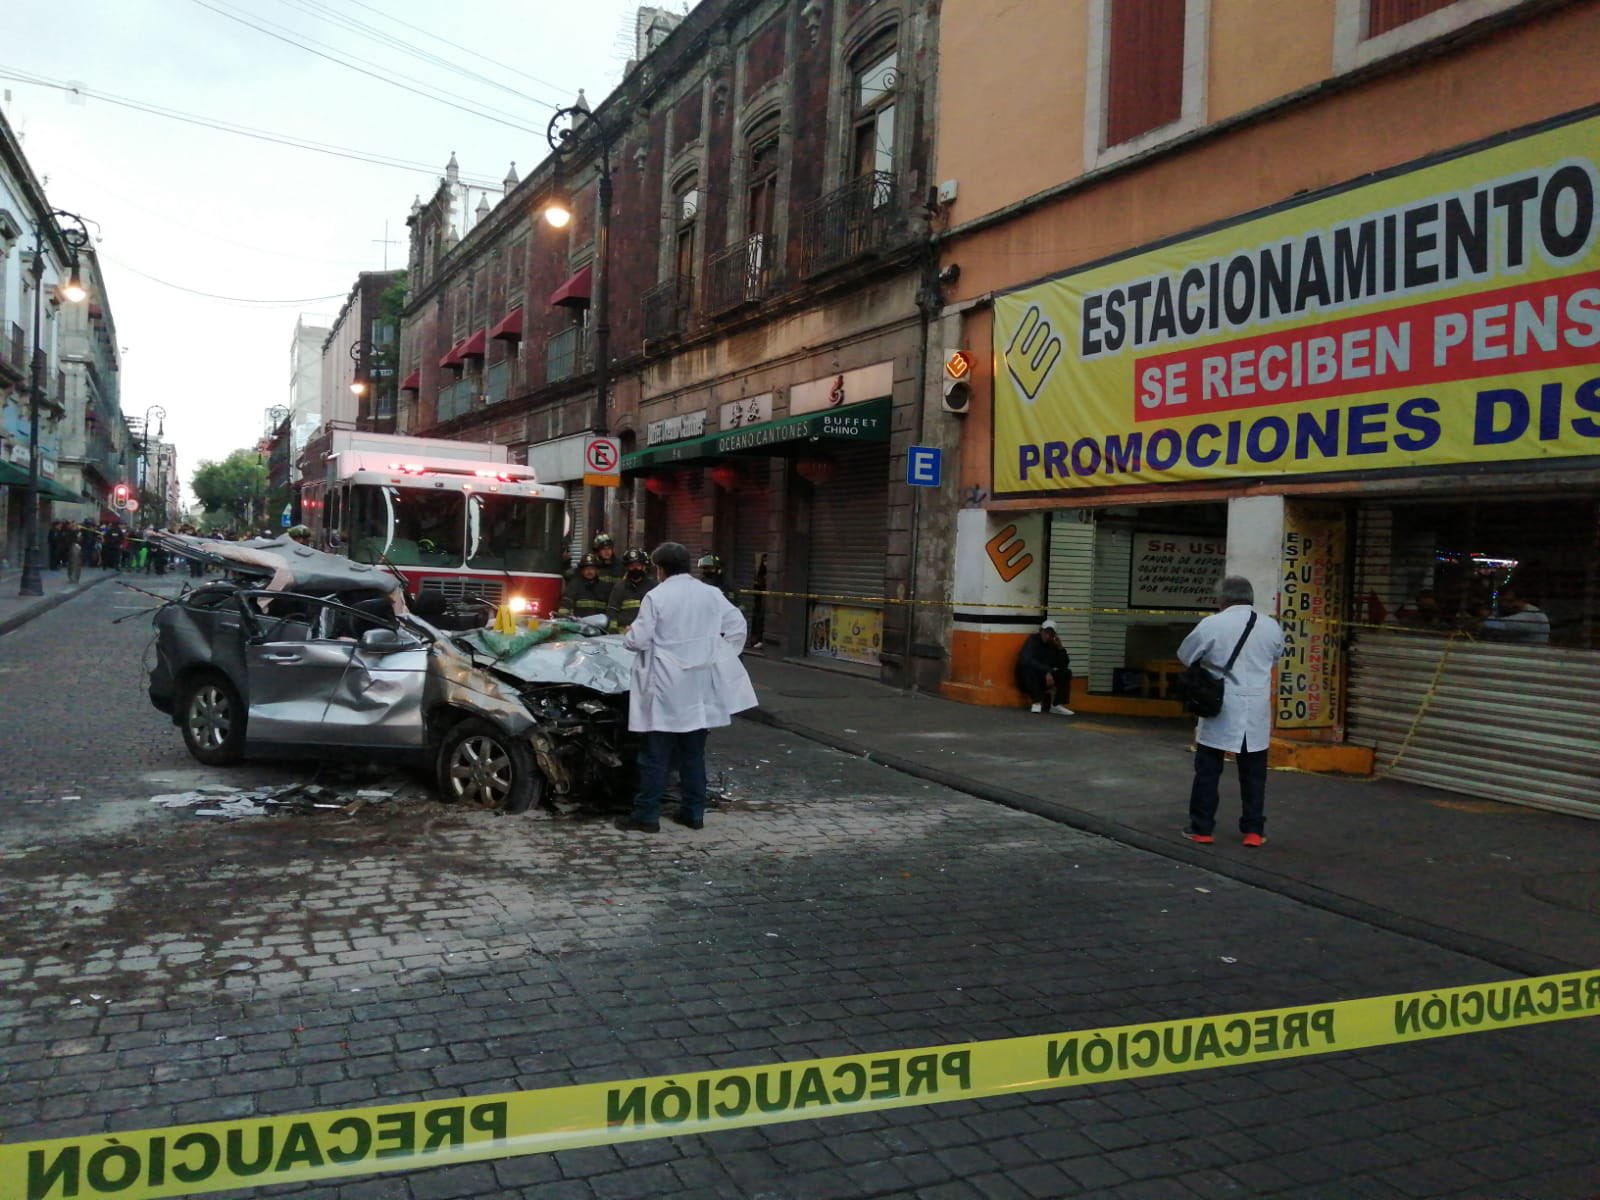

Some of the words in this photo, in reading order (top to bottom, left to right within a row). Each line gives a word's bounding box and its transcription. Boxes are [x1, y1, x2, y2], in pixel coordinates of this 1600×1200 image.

[1082, 164, 1594, 356] ESTACIONAMIENTO
[1140, 362, 1188, 410] SE
[1202, 322, 1411, 401] RECIBEN
[719, 432, 754, 452] OCEANO
[757, 421, 808, 444] CANTONES
[823, 416, 877, 427] BUFFET
[823, 426, 858, 435] CHINO
[1018, 397, 1442, 481] PROMOCIONES
[914, 452, 934, 481] E
[1148, 540, 1182, 553] SR.
[1279, 532, 1299, 721] ESTACIONAMIENTO
